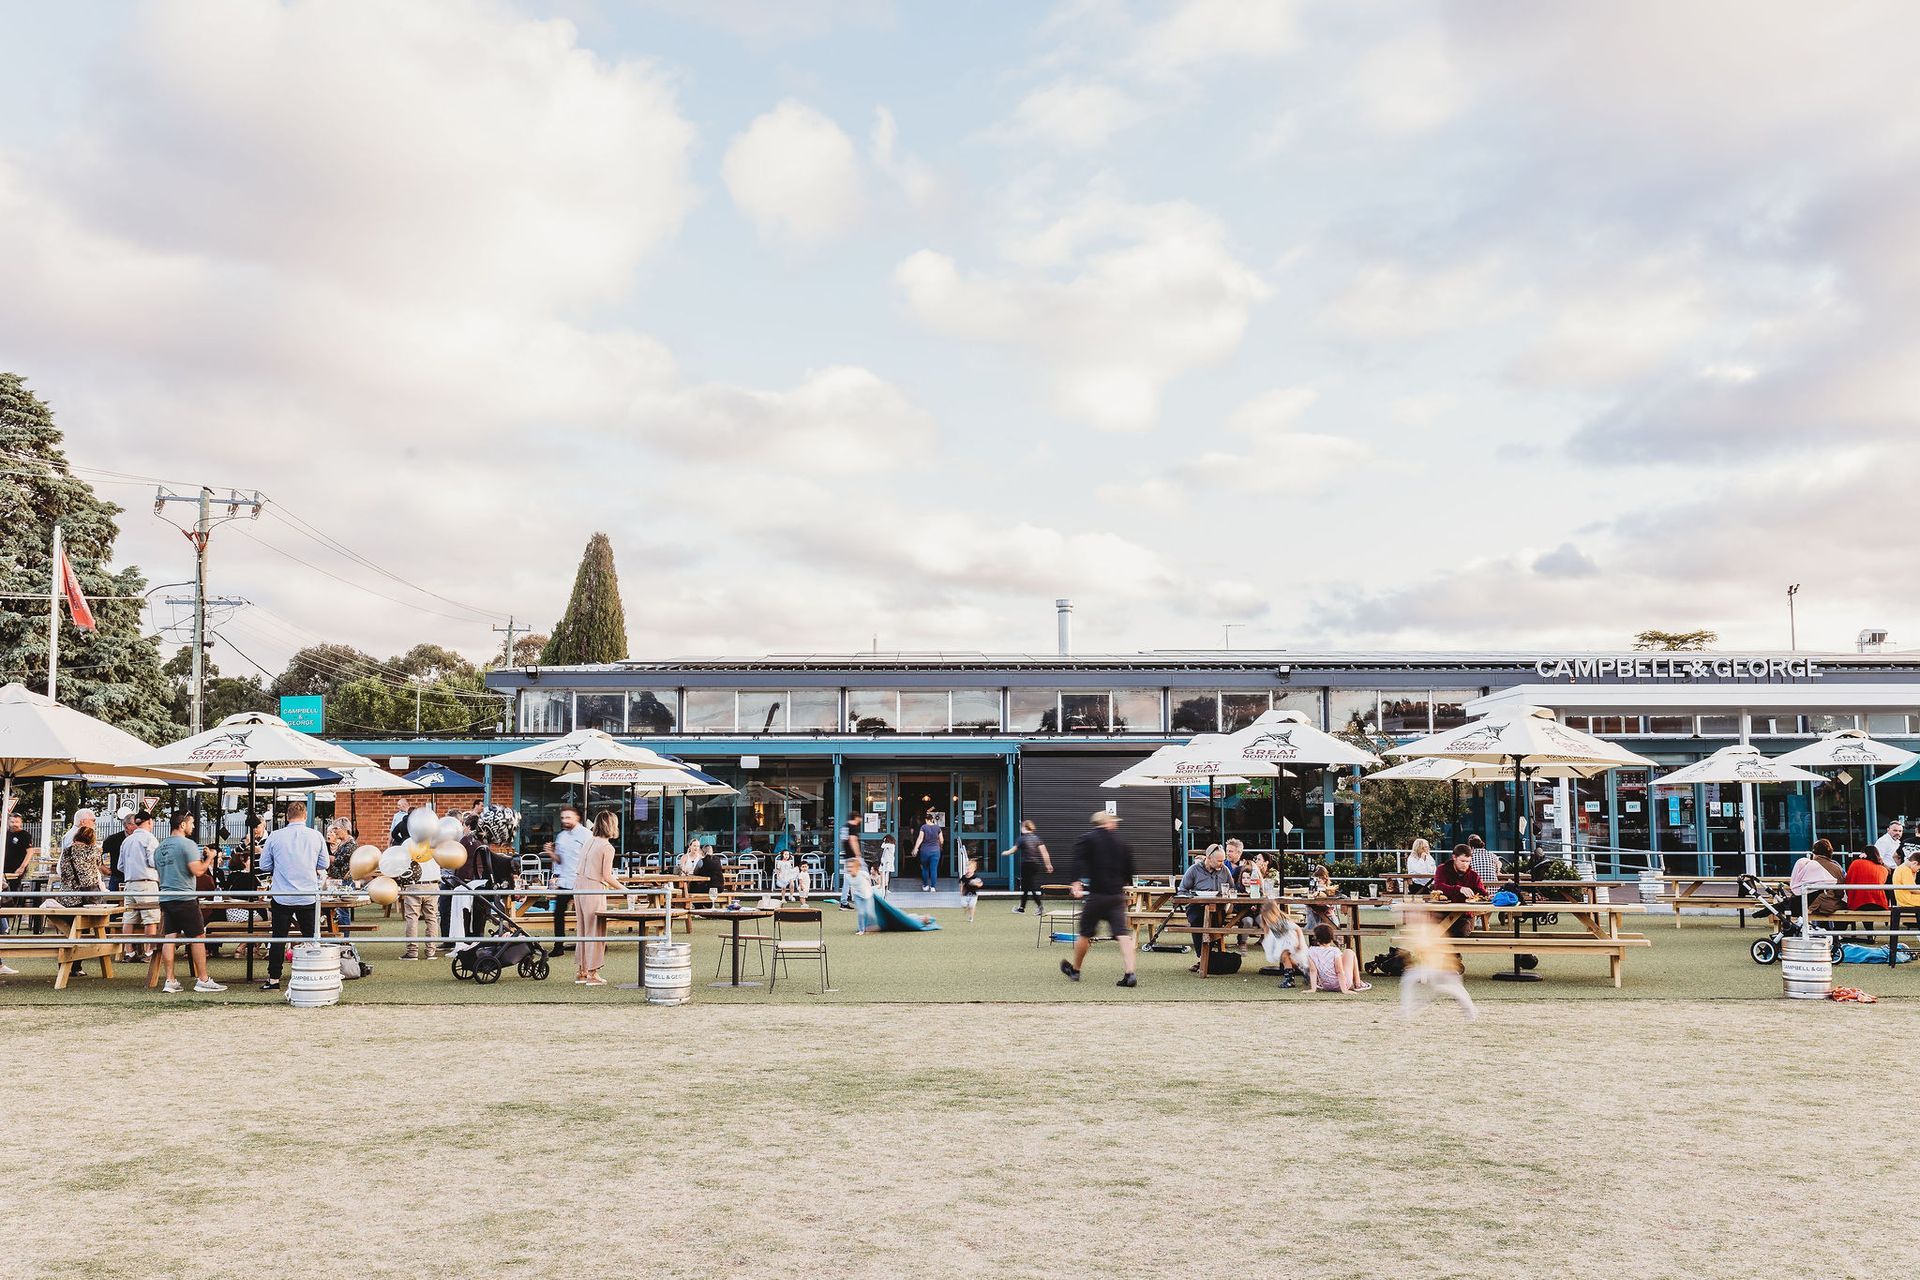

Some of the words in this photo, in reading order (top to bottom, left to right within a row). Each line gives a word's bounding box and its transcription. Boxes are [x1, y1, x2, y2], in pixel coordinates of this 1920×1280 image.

[1535, 658, 1685, 678] CAMPBELL
[1690, 658, 1710, 678] &
[1713, 658, 1824, 678] GEORGE
